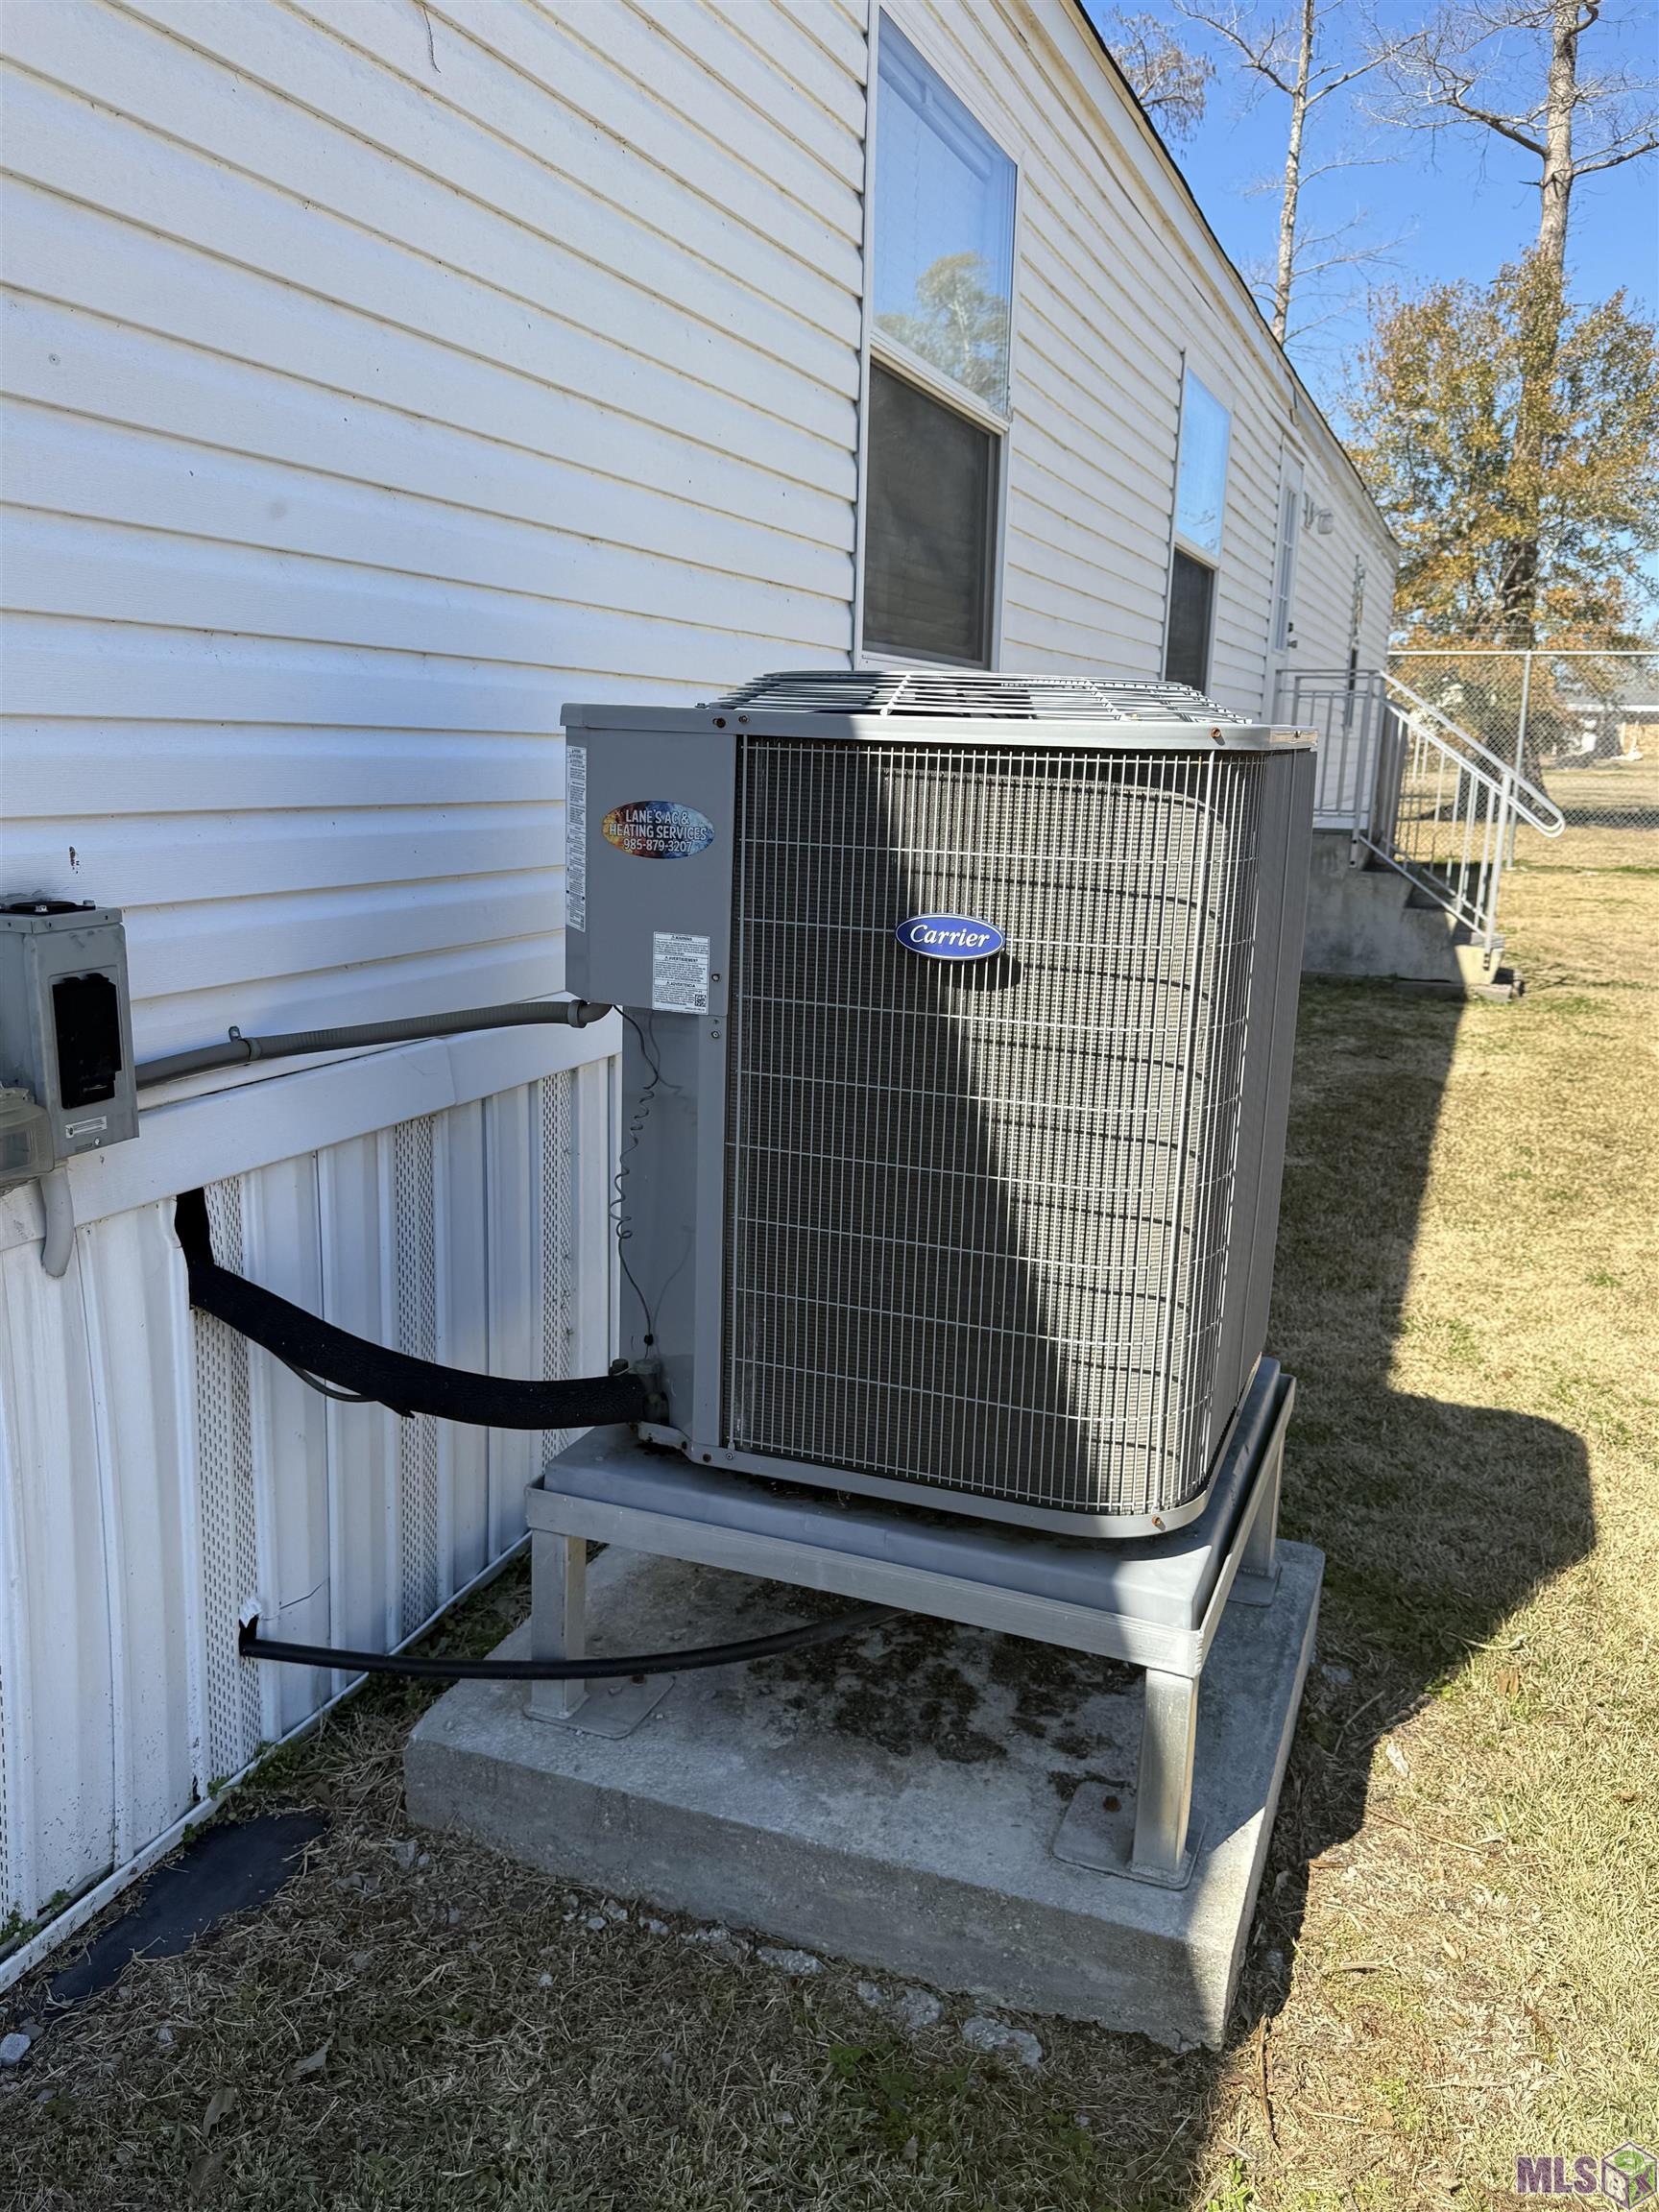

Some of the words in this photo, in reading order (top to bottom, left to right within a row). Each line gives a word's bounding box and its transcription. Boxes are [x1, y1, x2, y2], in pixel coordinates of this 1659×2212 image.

[625, 809, 662, 824] LANE'S
[664, 811, 680, 825] AC
[681, 811, 690, 825] &
[609, 823, 655, 838] HEATING
[656, 826, 708, 841] SERVICES
[623, 838, 692, 853] 985-879-3207
[910, 925, 991, 948] Carrier
